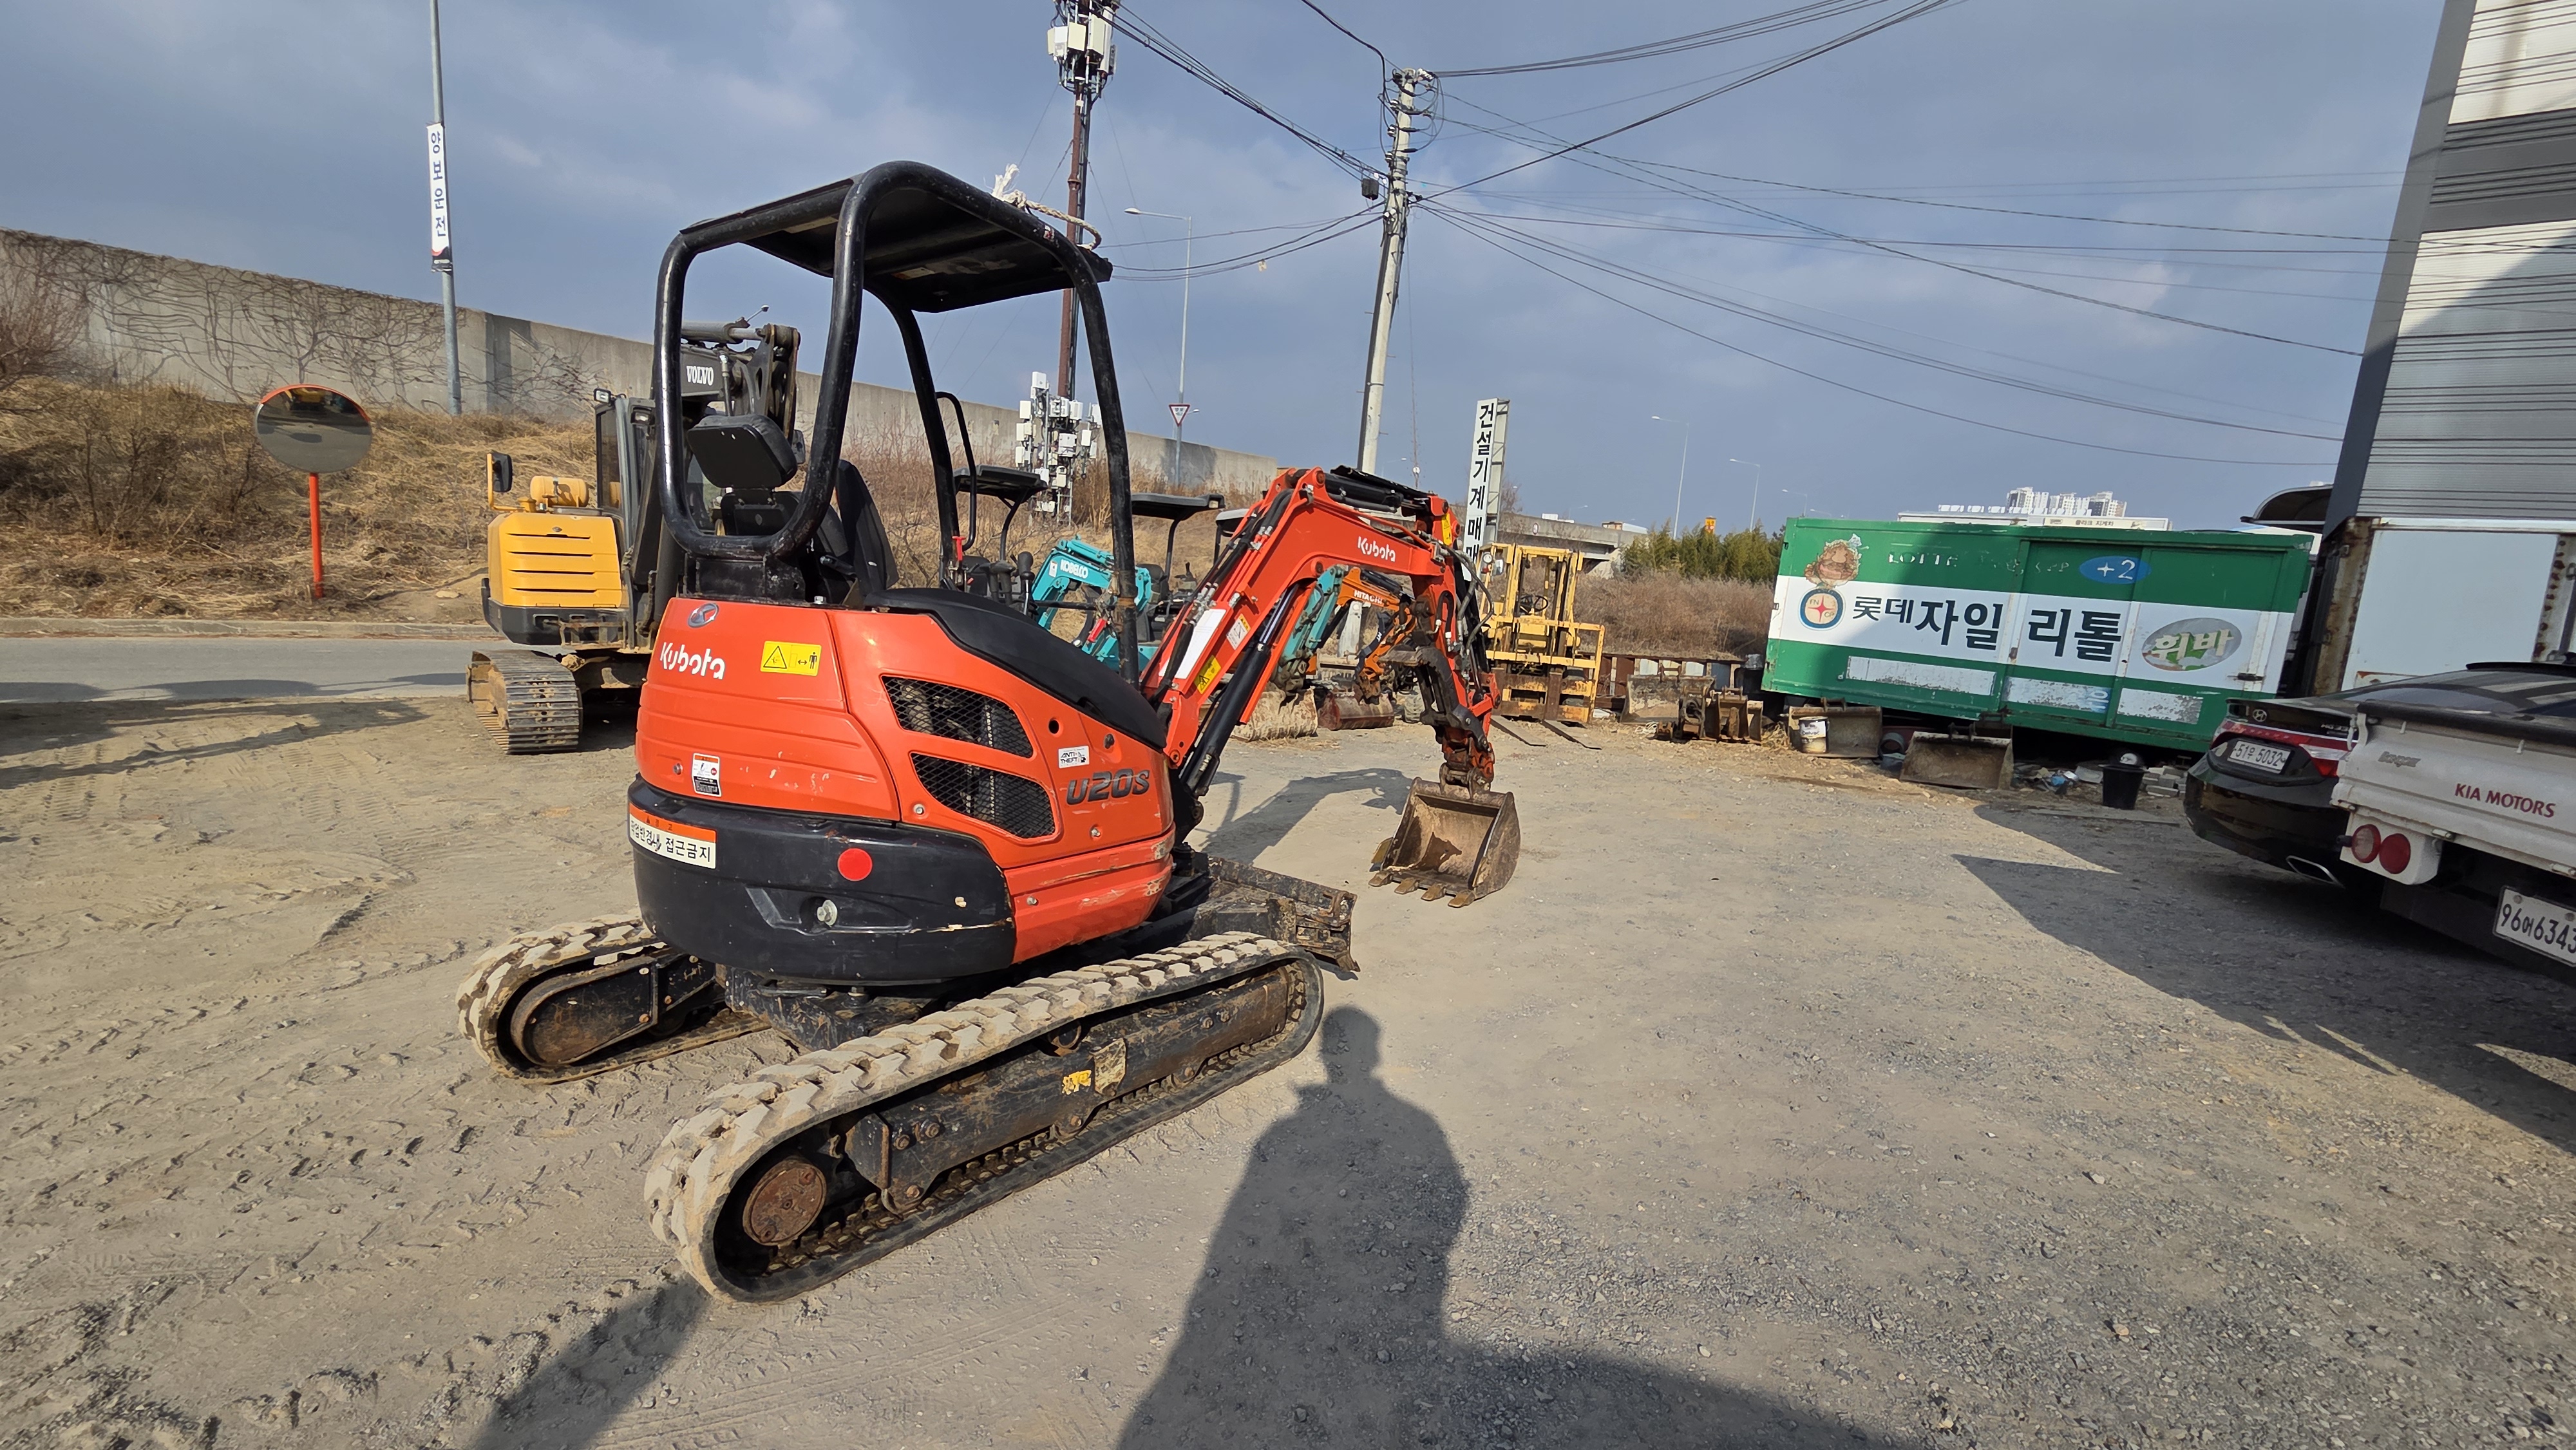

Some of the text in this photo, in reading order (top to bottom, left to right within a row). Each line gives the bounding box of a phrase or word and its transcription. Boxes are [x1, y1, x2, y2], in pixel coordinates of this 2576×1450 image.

[431, 131, 446, 237] 양보운전
[687, 366, 714, 386] VOLVO
[1358, 536, 1396, 562] Kubota
[1060, 559, 1088, 579] KOBELCO
[1354, 590, 1383, 604] HITACHI
[2152, 629, 2234, 661] 휘바
[659, 642, 726, 680] Kubota
[2256, 748, 2283, 767] 5032
[1066, 768, 1150, 805] U20S
[2455, 783, 2556, 818] KIA MOTORS
[665, 838, 710, 863] 접근금지
